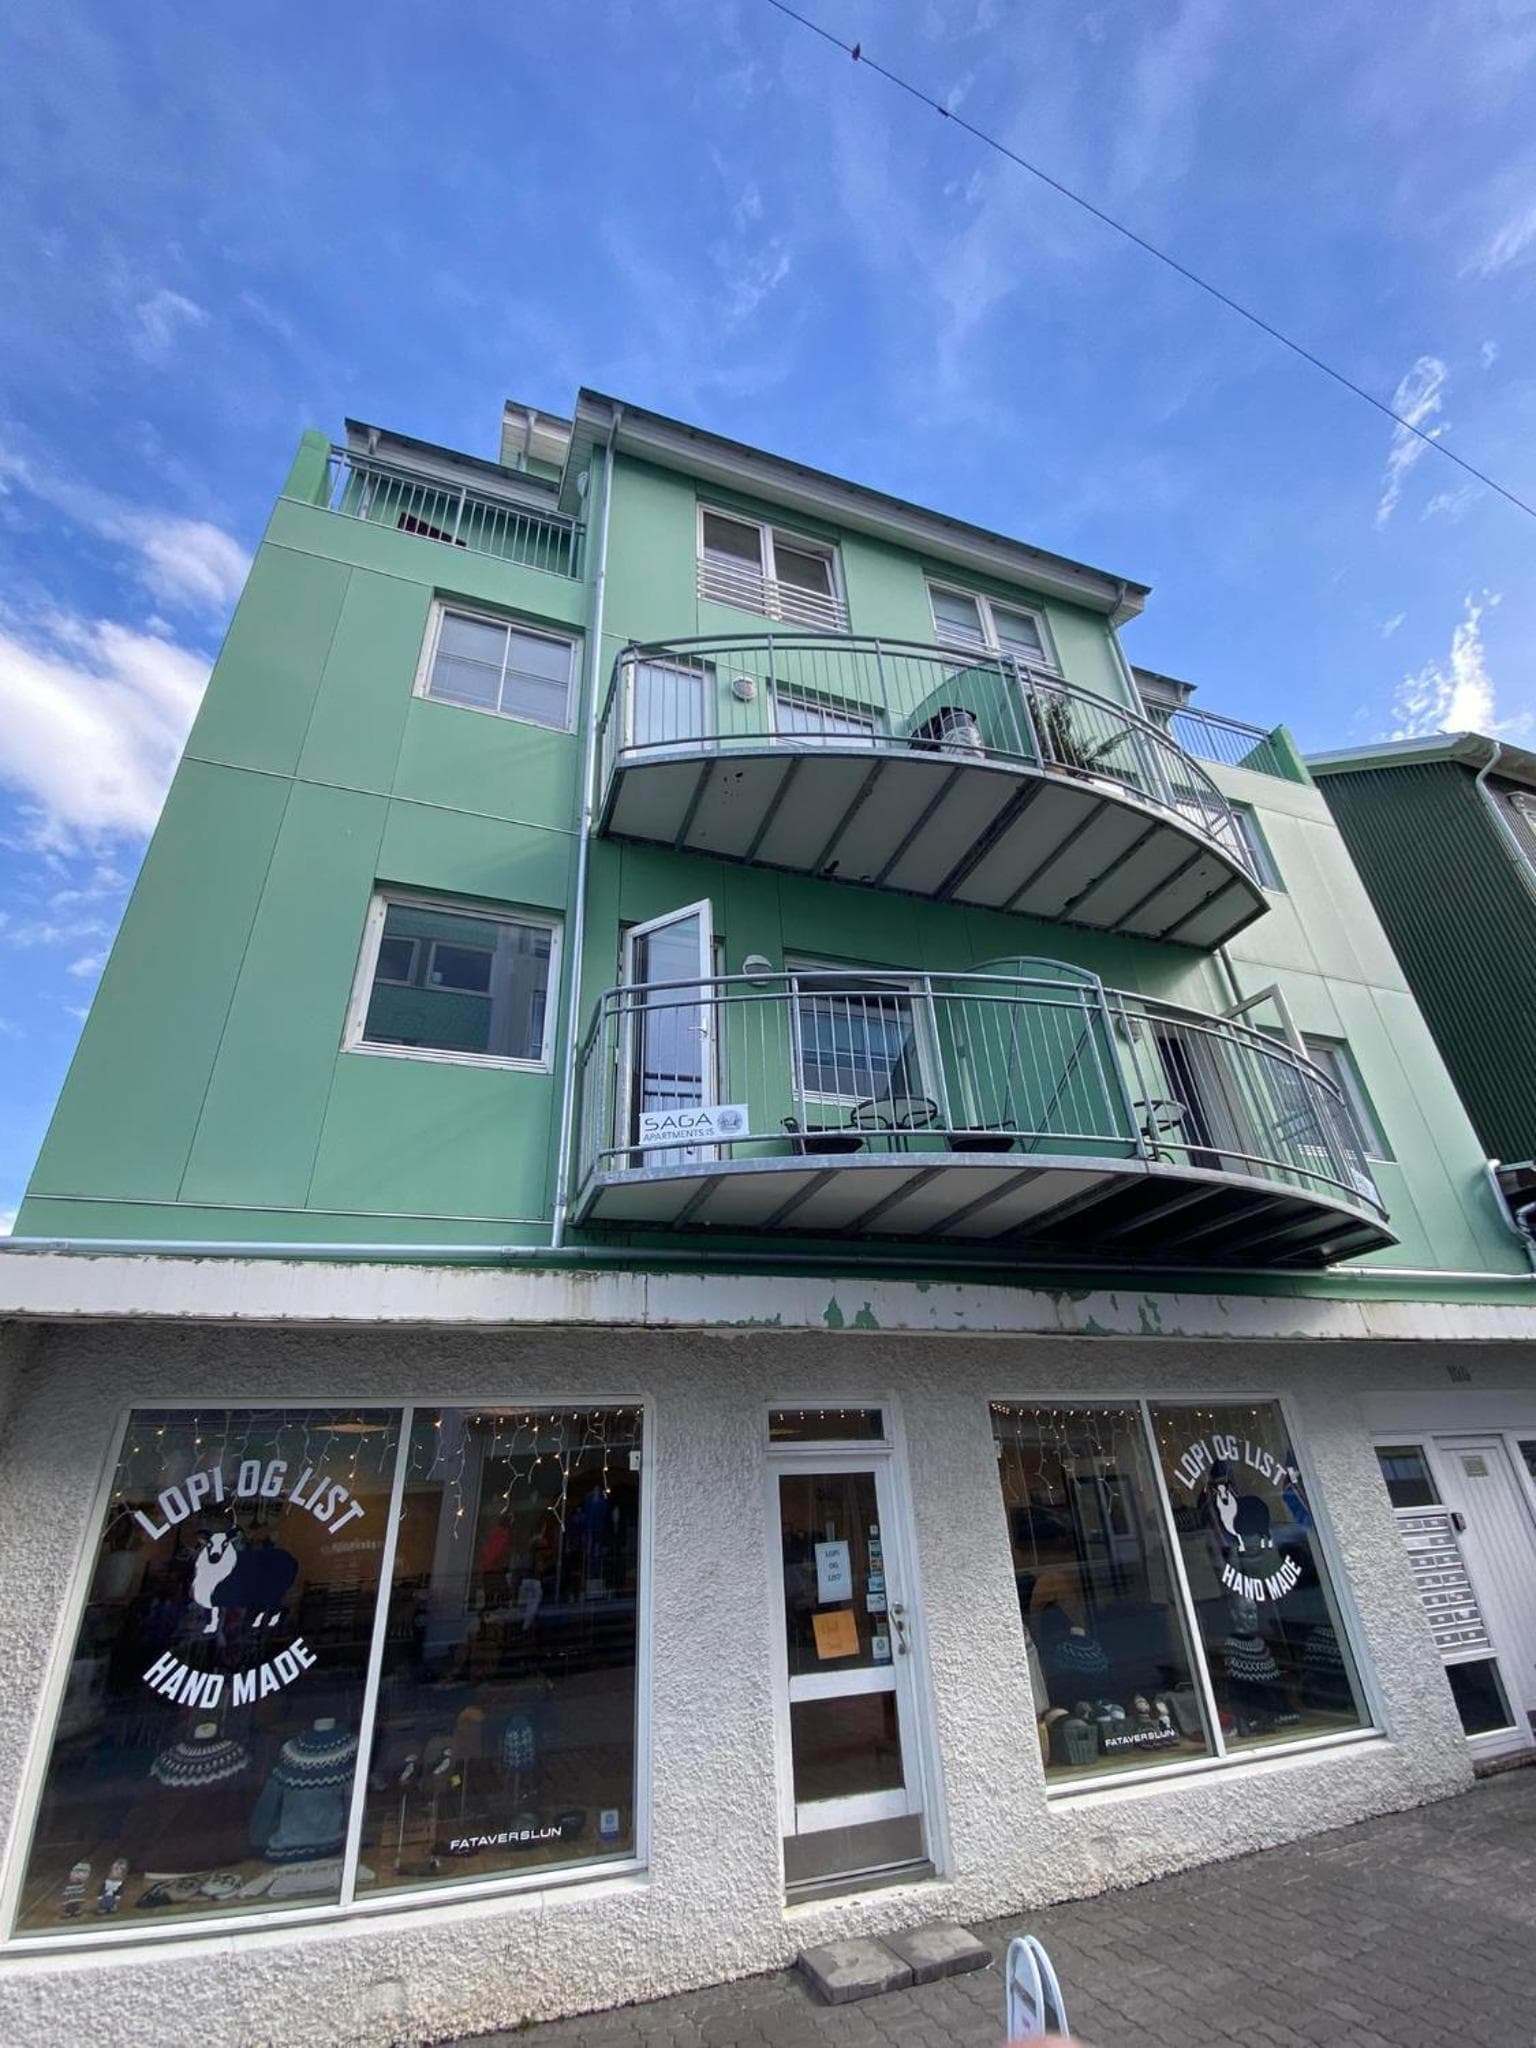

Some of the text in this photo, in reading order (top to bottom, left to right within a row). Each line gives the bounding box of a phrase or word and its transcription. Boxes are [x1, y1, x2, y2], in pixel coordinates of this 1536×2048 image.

[644, 1113, 713, 1131] SAGA
[1174, 1435, 1287, 1490] LOPI OG LIST
[134, 1460, 365, 1540] LOPI OG LIST
[1222, 1555, 1302, 1602] HAND MADE
[142, 1637, 318, 1709] HAND MADE
[450, 1826, 563, 1850] FATAVERSLUN
